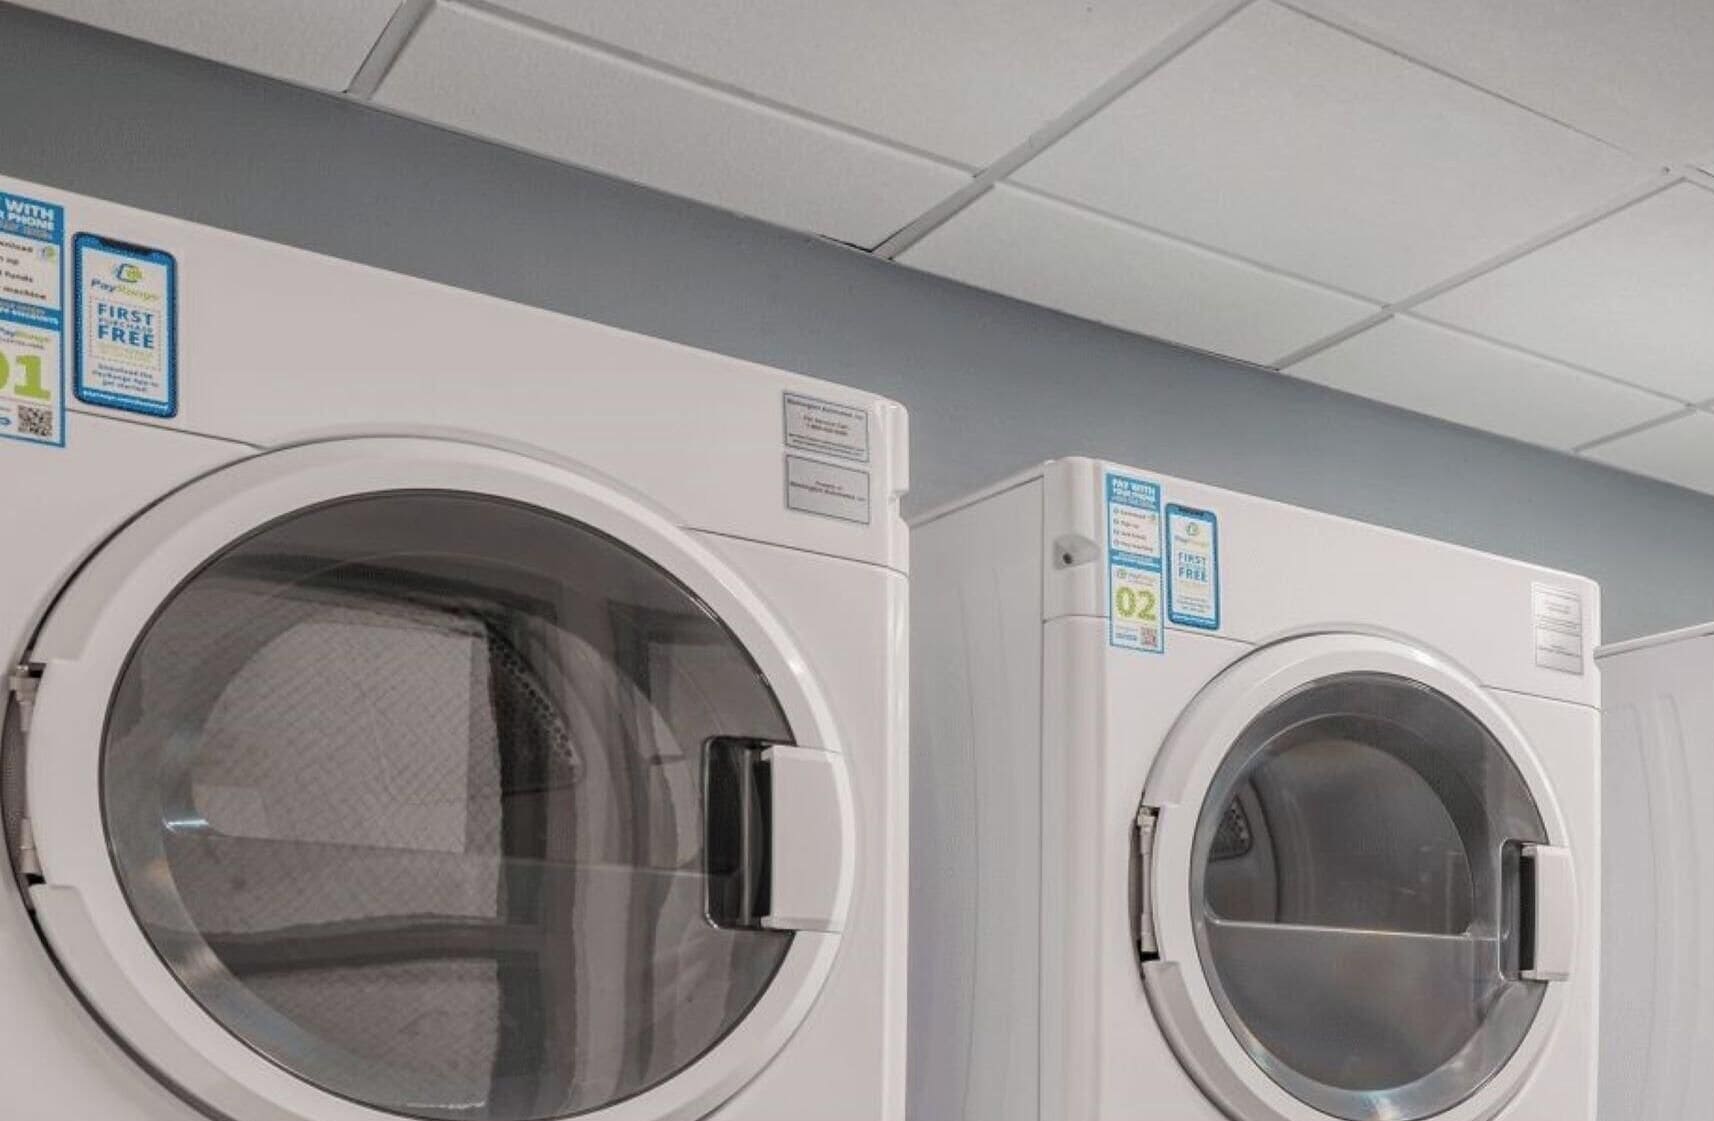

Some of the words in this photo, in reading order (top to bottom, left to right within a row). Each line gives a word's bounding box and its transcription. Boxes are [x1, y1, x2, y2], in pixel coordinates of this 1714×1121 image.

[5, 198, 54, 221] WITH
[7, 211, 54, 231] PHONE
[97, 302, 155, 326] FIRST
[97, 324, 155, 349] FREE
[1178, 567, 1208, 583] FREE
[1115, 585, 1156, 621] 02
